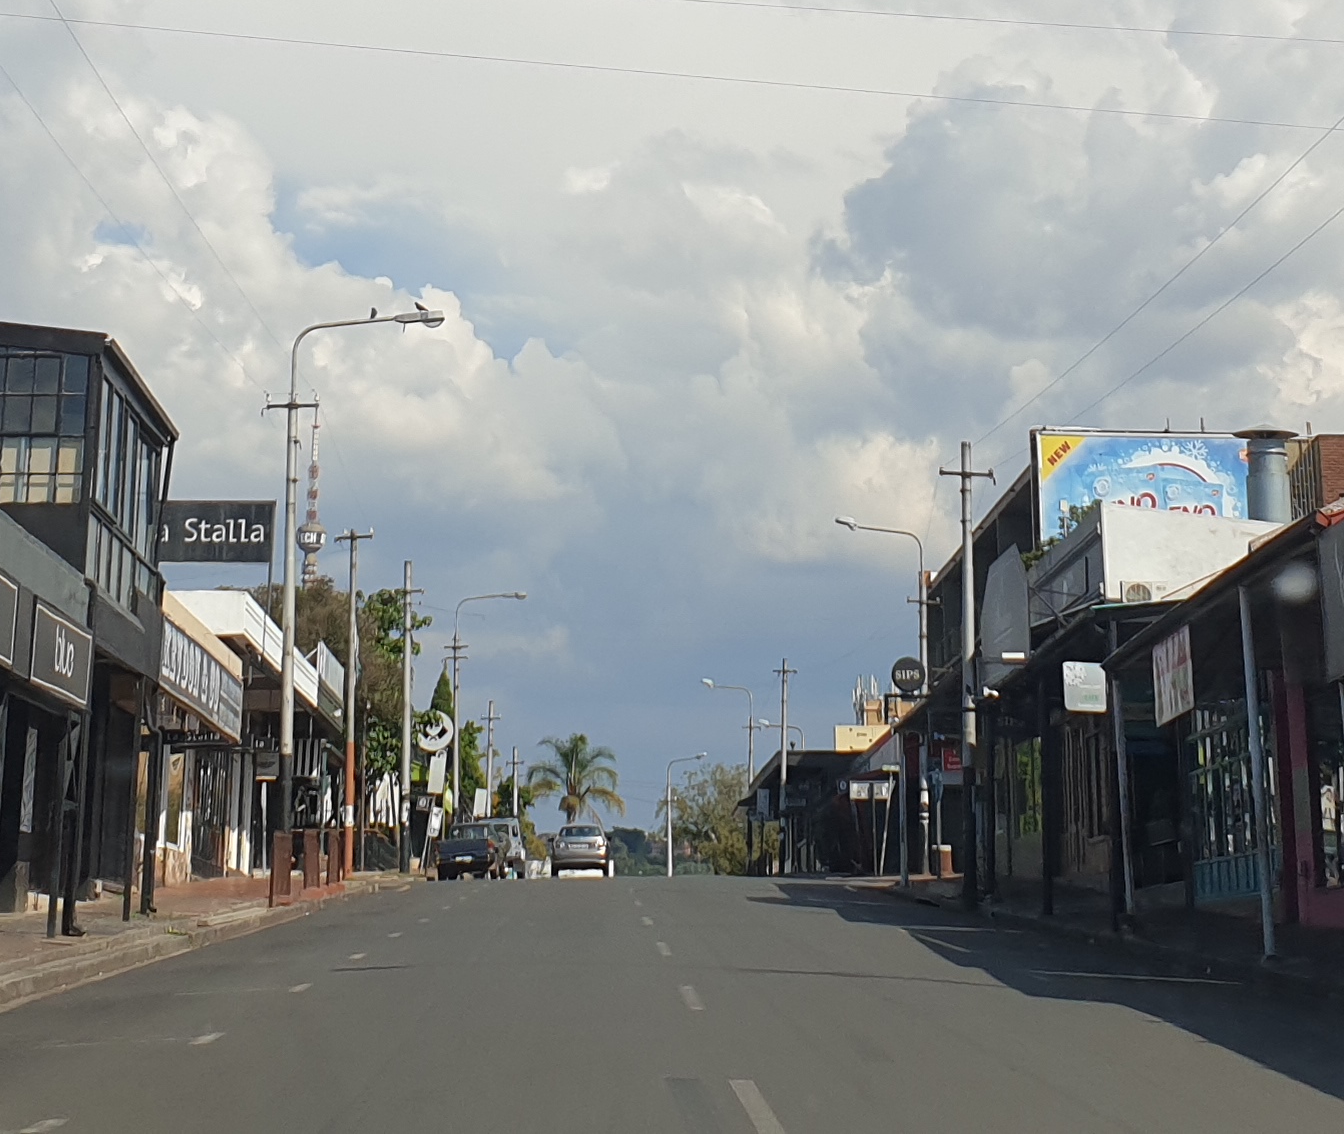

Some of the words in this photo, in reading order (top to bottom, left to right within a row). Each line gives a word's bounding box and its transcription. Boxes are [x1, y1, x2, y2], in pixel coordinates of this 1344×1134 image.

[1047, 440, 1071, 466] NEW
[183, 517, 265, 543] Stalla
[894, 668, 920, 681] SIPS
